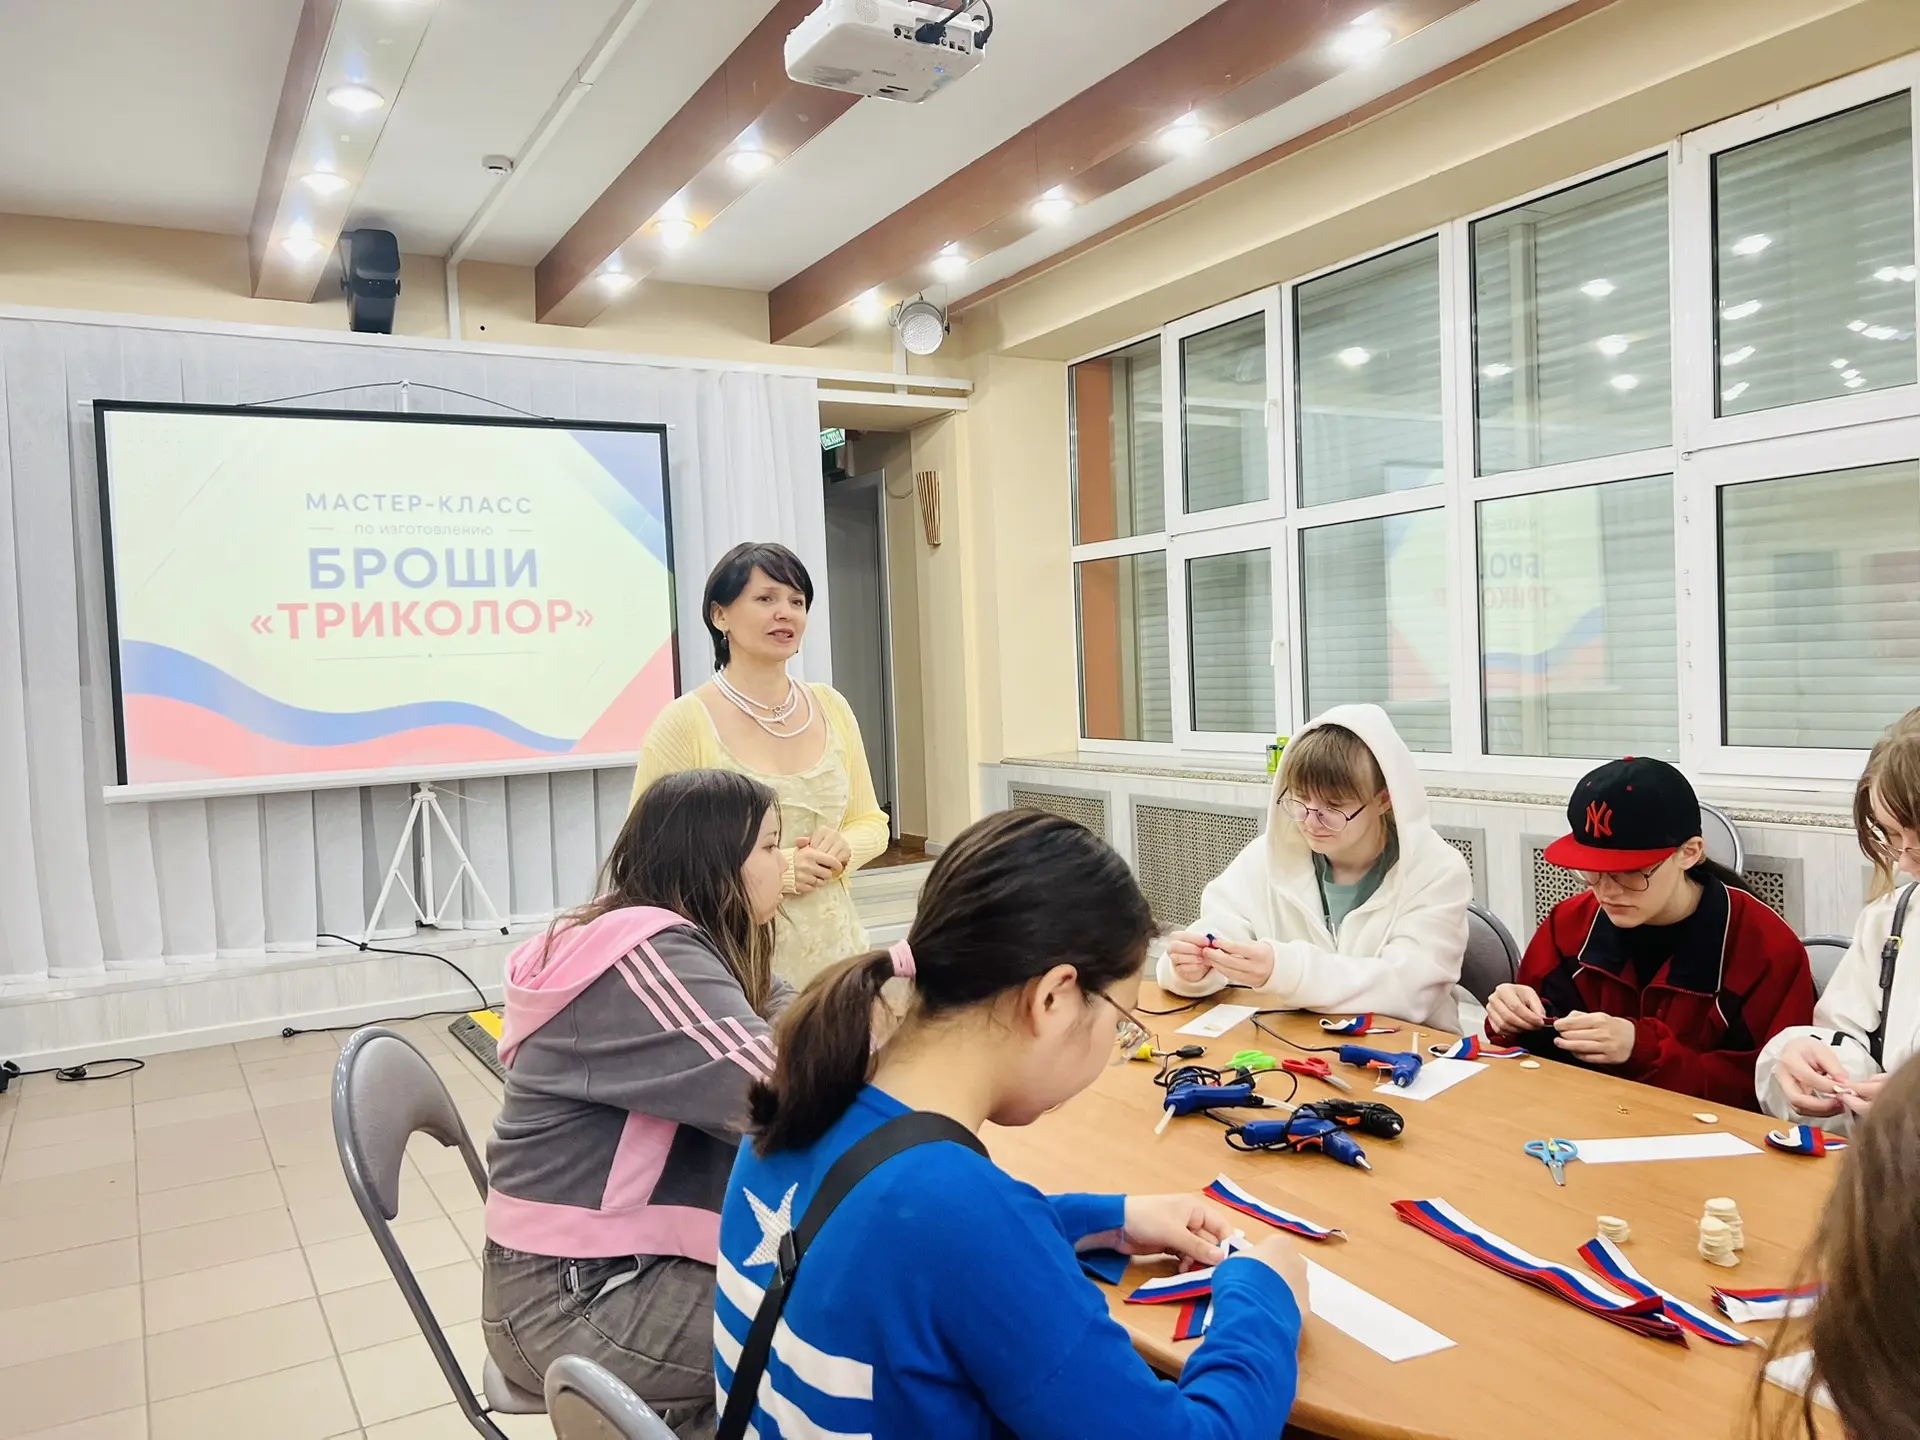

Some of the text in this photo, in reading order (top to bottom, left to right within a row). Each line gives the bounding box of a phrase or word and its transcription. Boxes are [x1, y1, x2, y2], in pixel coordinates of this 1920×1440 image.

[305, 492, 532, 514] МАСТЕР-КЛАСС
[354, 524, 494, 537] по изготовлению
[308, 547, 538, 590] БРОШИ
[250, 599, 594, 640] «ТРИКОЛОР»
[1585, 800, 1613, 838] NY
